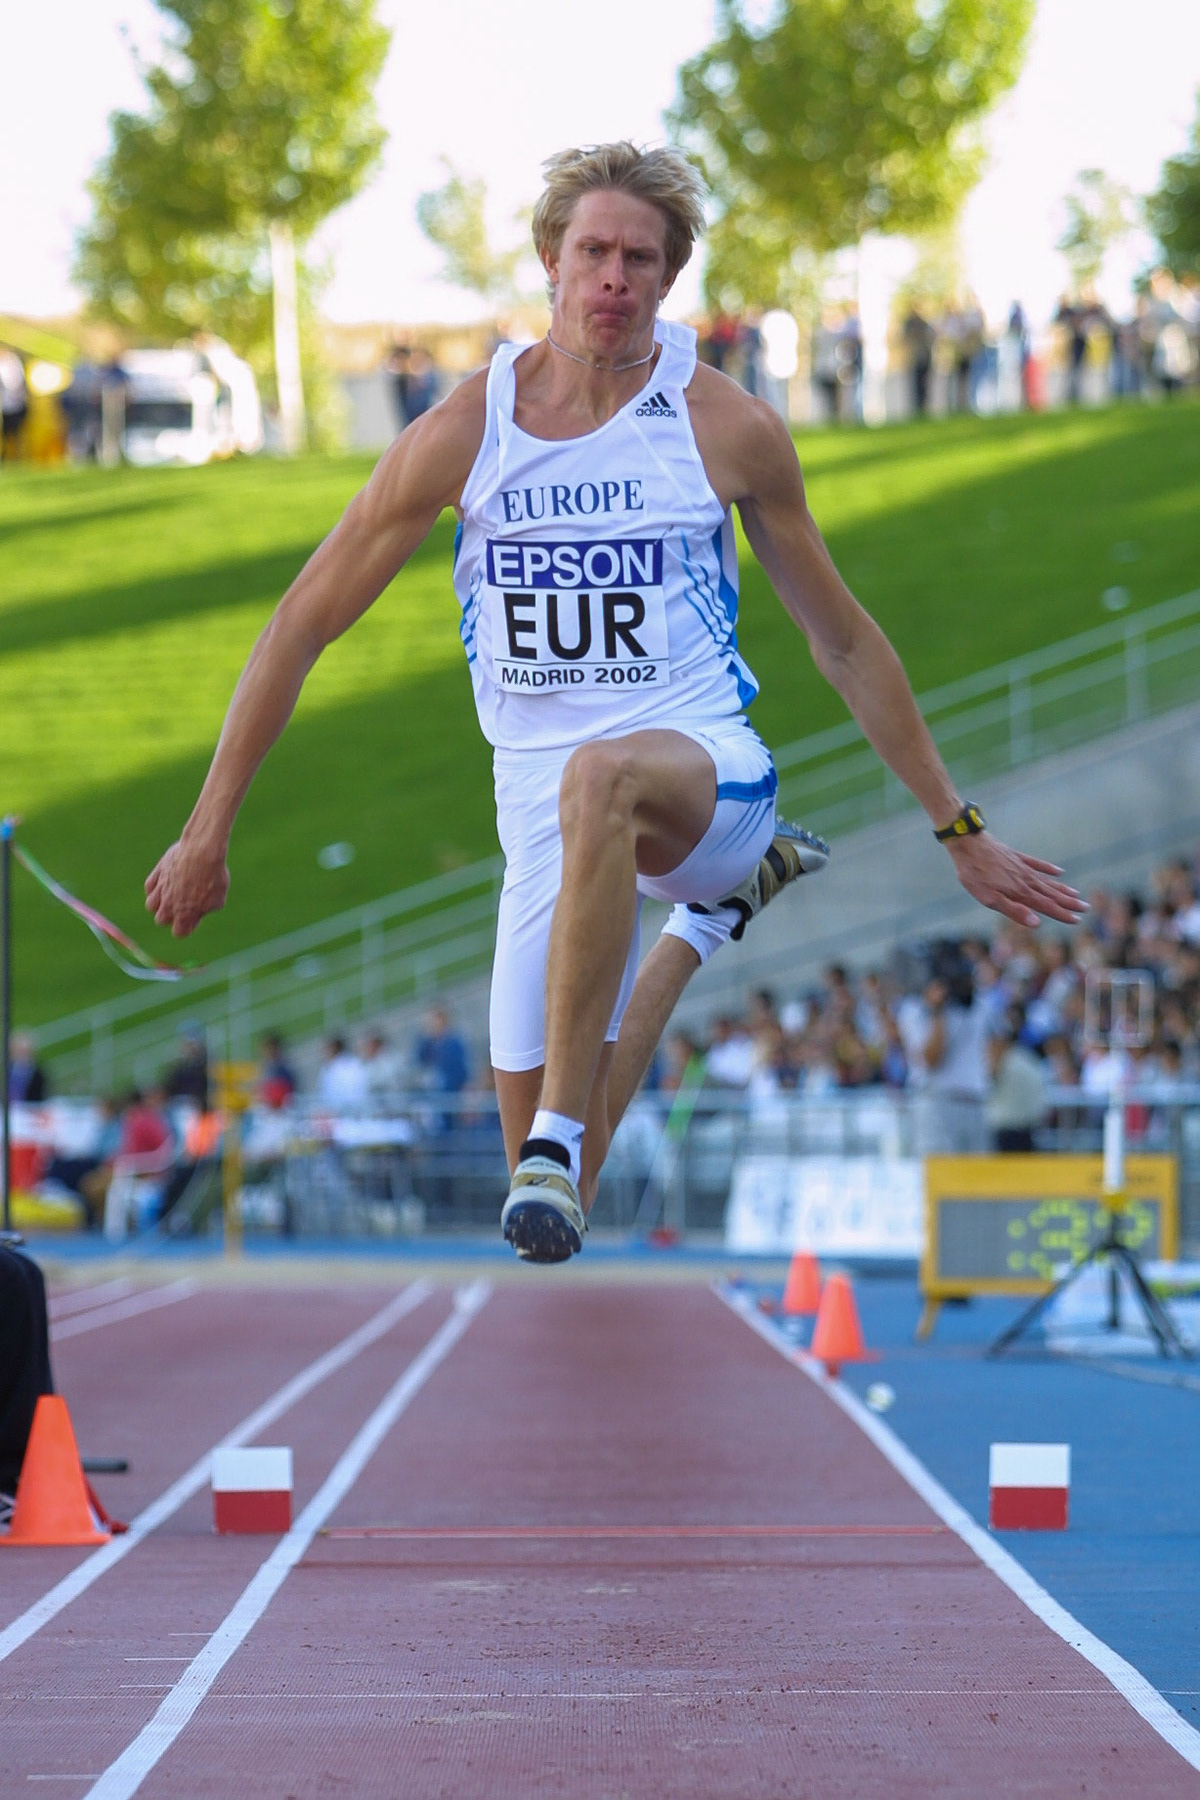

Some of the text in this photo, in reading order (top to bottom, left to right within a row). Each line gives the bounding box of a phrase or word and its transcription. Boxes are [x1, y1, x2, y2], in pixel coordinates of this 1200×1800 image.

[635, 406, 677, 418] adidas
[500, 480, 644, 523] EUROPE
[492, 544, 655, 587] EPSON
[503, 592, 649, 660] EUR
[501, 665, 657, 687] MADRID 2002
